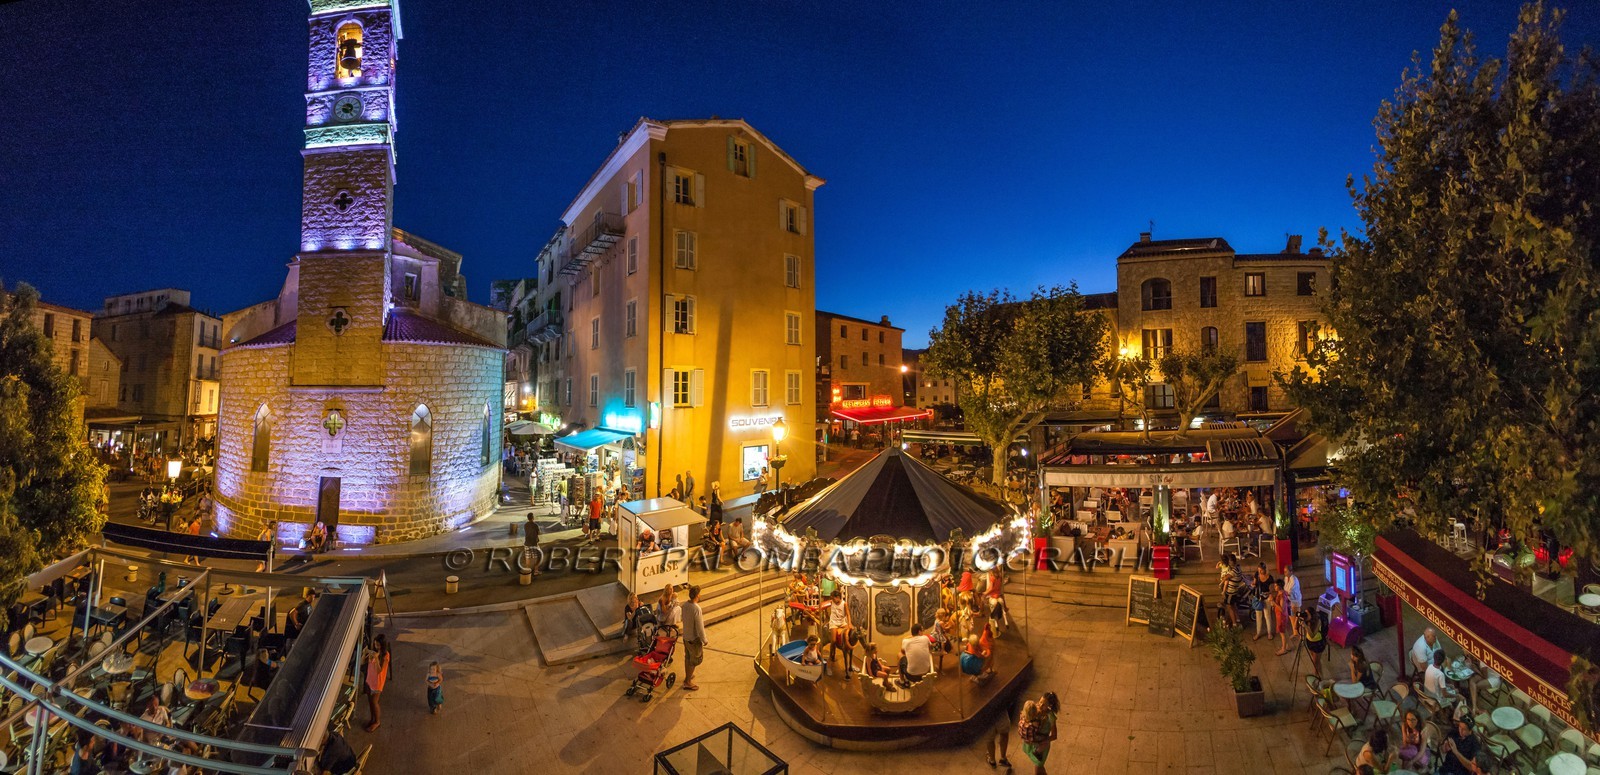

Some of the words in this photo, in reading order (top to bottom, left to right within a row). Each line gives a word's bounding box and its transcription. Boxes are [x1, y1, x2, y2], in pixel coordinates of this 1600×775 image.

[642, 560, 679, 578] CAISSE
[1416, 598, 1426, 615] Le
[1426, 607, 1456, 638] Glacier
[1456, 632, 1469, 649] de
[1470, 640, 1481, 658] la
[1483, 648, 1514, 682] Place
[1538, 684, 1572, 712] GLACES
